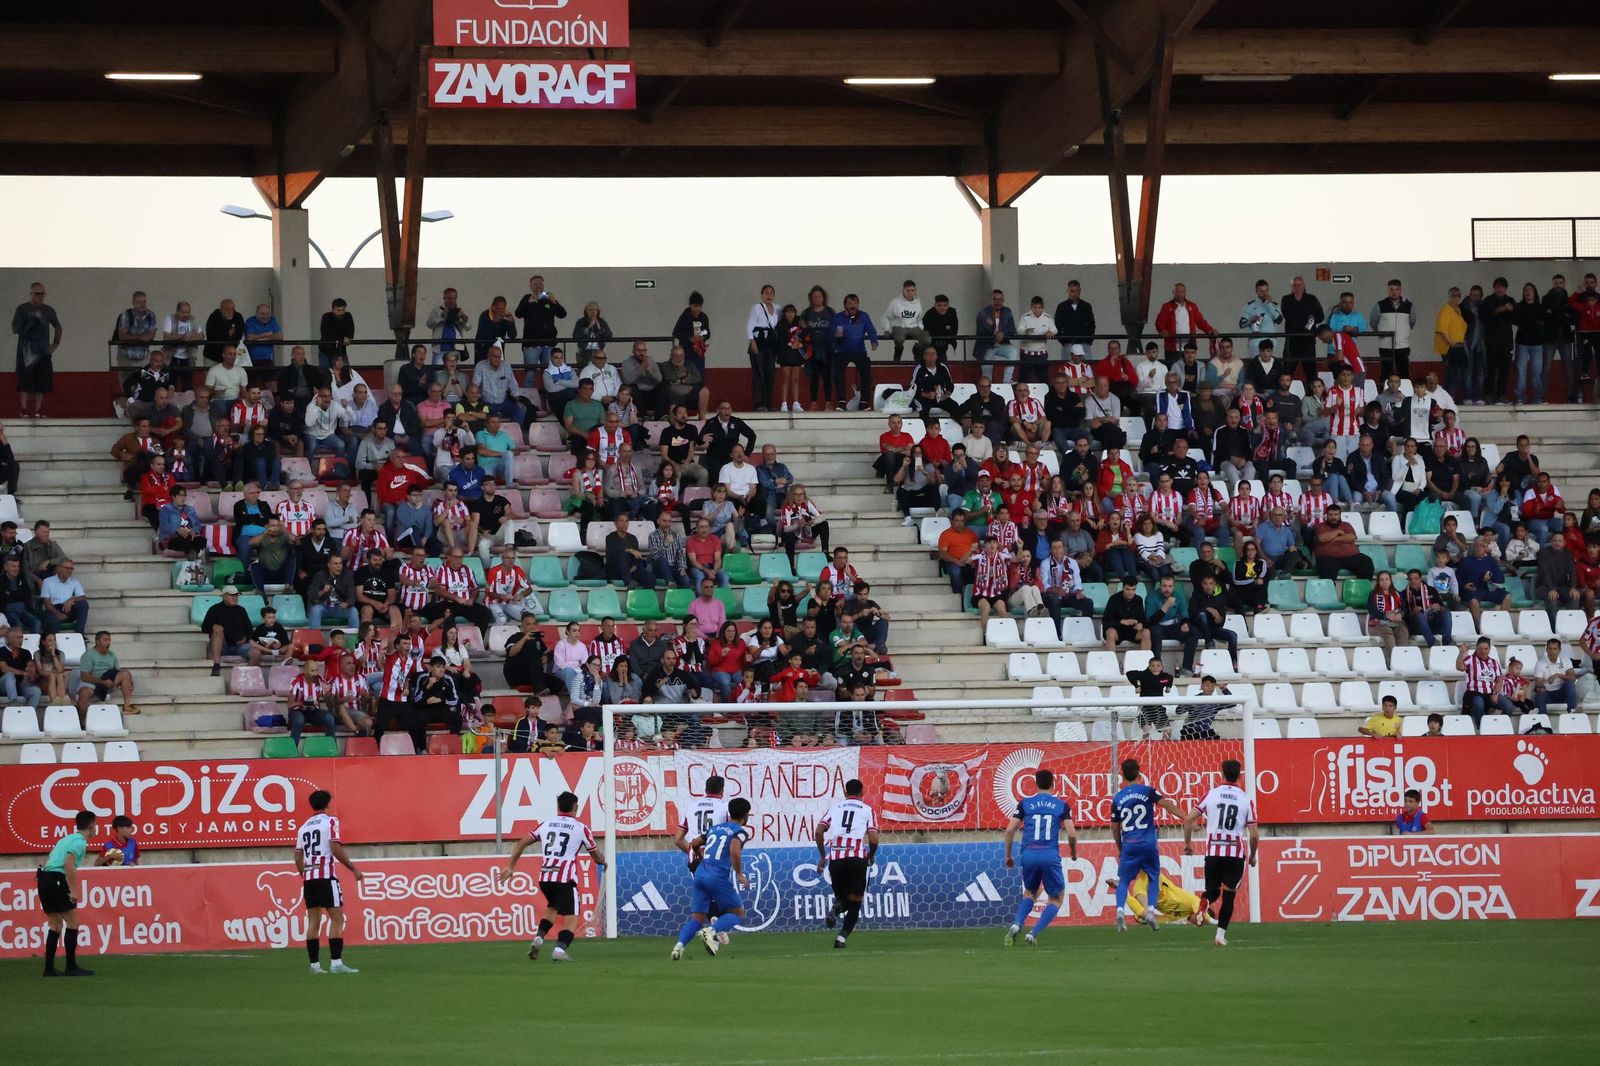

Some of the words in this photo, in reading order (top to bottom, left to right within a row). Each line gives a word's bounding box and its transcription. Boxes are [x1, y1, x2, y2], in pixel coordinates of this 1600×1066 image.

[456, 14, 608, 45] FUNDACIÓN
[434, 63, 631, 104] ZAMORACF
[1159, 763, 1279, 796] ÓPTO
[1337, 743, 1436, 790] fisio
[1339, 778, 1453, 814] readpt
[1340, 806, 1403, 816] POLICLÍNI
[1467, 782, 1596, 816] podoactiva
[1485, 805, 1531, 816] PODOLOGÍA
[1532, 806, 1538, 815] Y
[1539, 804, 1595, 815] BIOMECÁNICA
[178, 822, 188, 833] Y
[196, 818, 297, 834] JAMONES
[694, 809, 715, 835] 16
[841, 810, 856, 834] 4
[1032, 813, 1054, 841] 11
[1120, 803, 1149, 833] 22
[1216, 802, 1239, 831] 18
[302, 828, 322, 858] 22
[544, 831, 571, 858] 23
[703, 833, 728, 861] 21
[0, 881, 43, 911] Car
[77, 879, 152, 909] Joven
[357, 866, 539, 901] Escuela
[1336, 885, 1517, 922] ZAMORA
[97, 924, 112, 955] y
[119, 913, 182, 945] León
[363, 903, 539, 941] infantil
